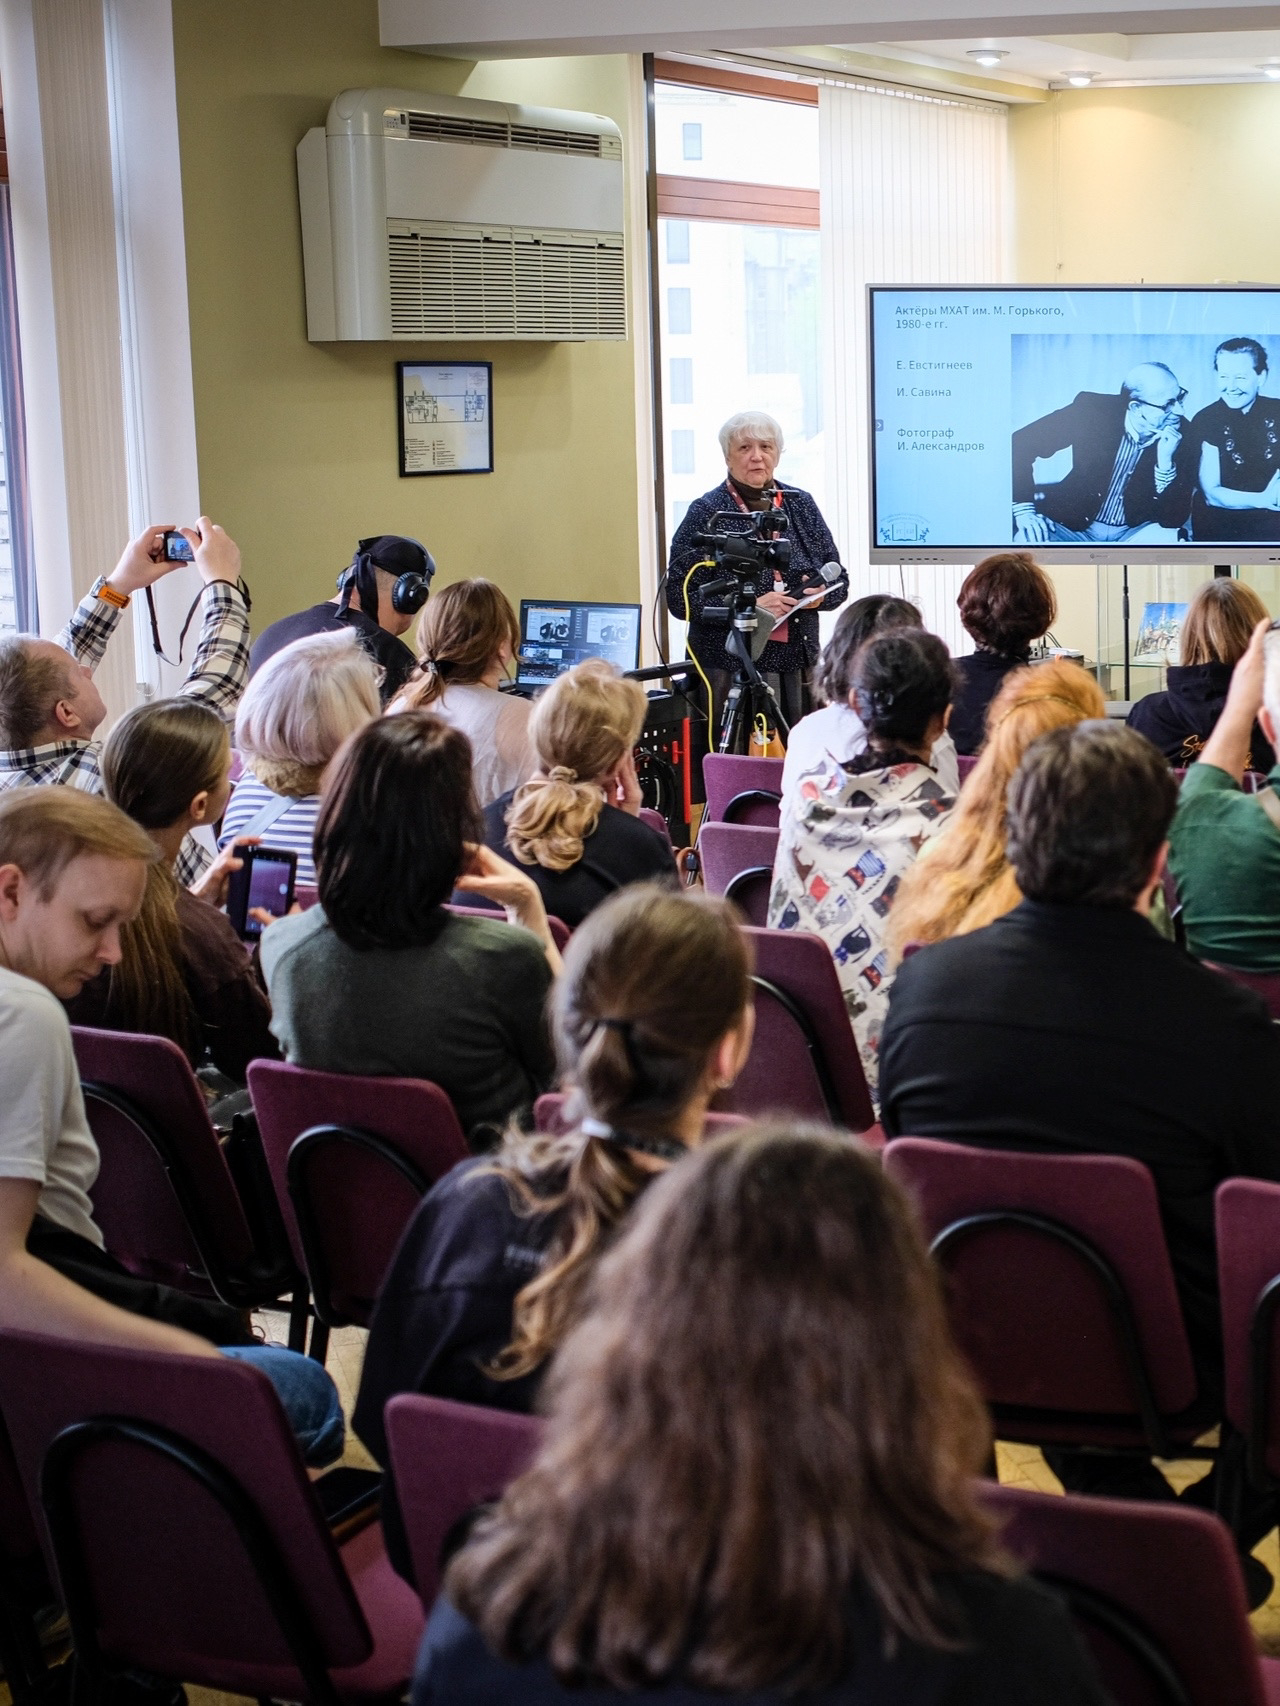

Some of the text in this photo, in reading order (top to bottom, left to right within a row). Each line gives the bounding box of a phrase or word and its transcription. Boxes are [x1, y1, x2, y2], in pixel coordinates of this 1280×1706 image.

[895, 305, 937, 318] Актёры
[940, 305, 969, 315] МХАТ
[993, 305, 1006, 315] М.
[1008, 305, 1065, 318] Горького,
[895, 319, 948, 329] 1980-е гг.
[896, 360, 973, 370] Е. Евстигнеев
[896, 387, 952, 397] И. Савина
[897, 427, 954, 440] Фотограф
[897, 441, 985, 453] И. Александров
